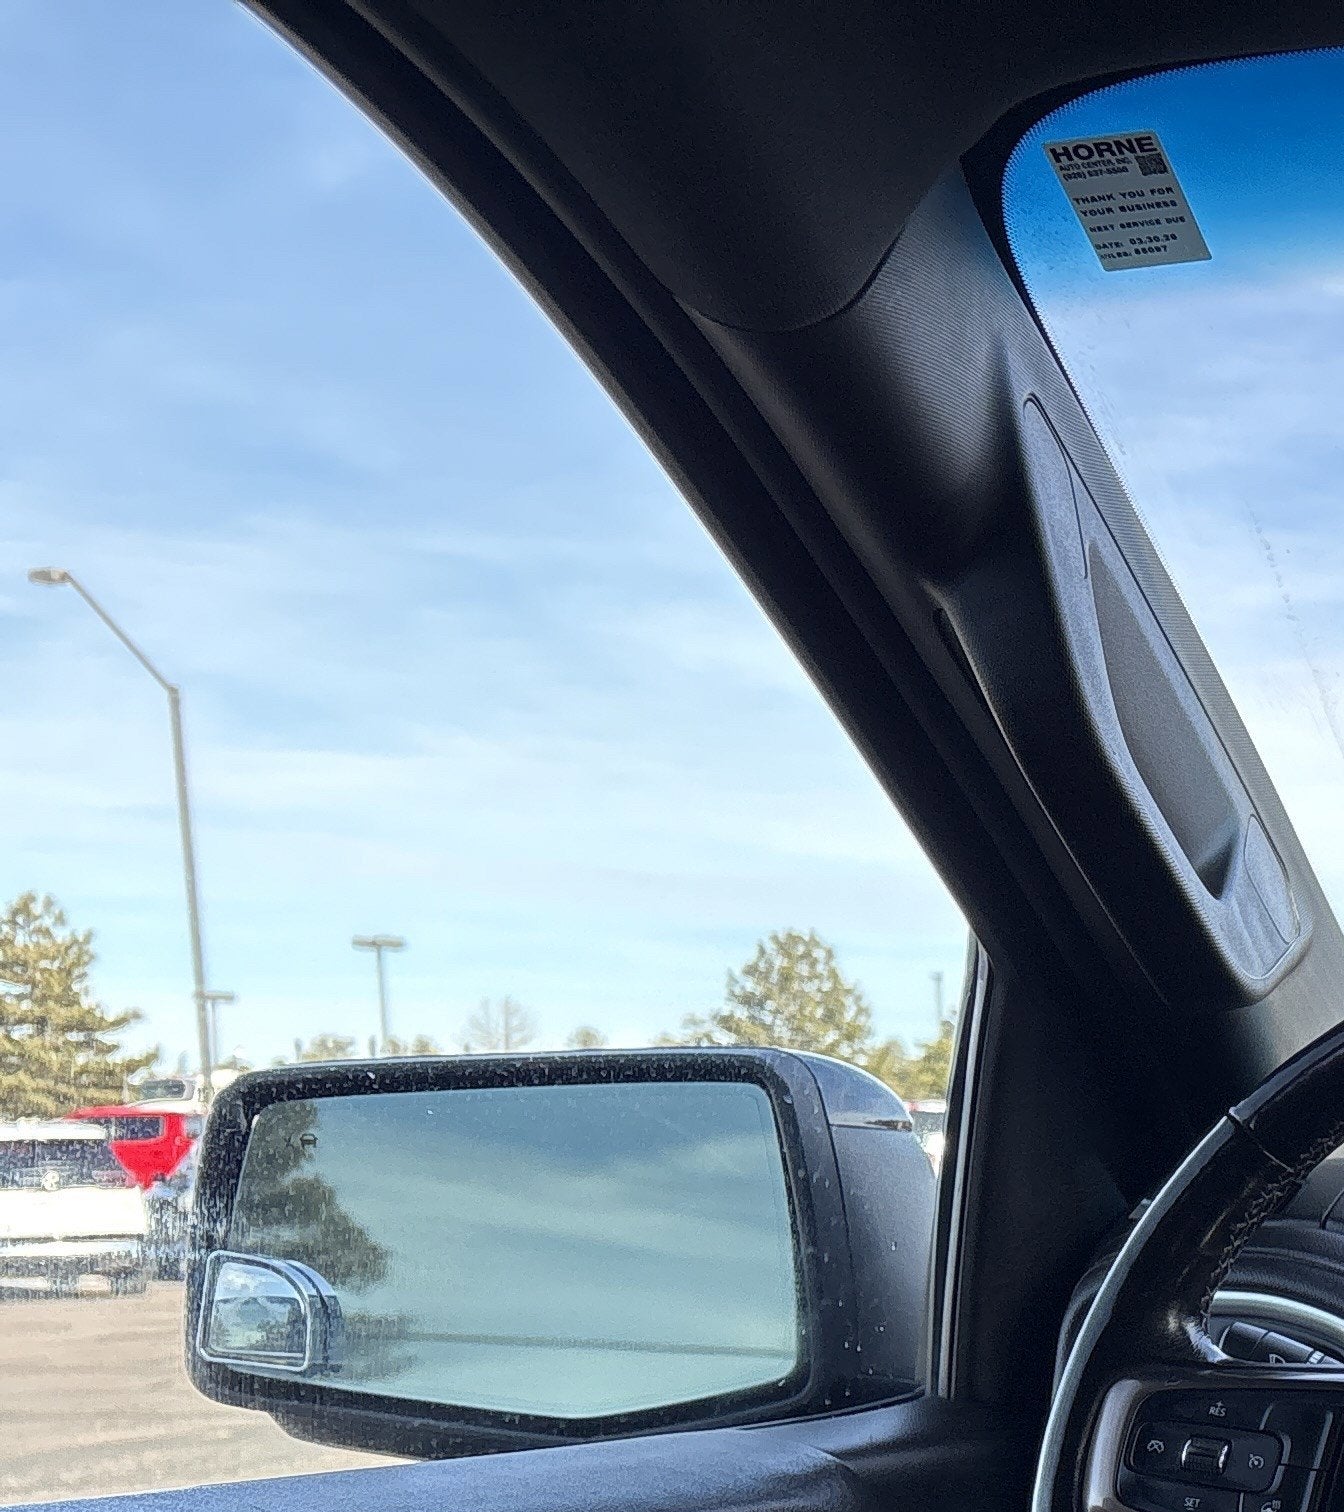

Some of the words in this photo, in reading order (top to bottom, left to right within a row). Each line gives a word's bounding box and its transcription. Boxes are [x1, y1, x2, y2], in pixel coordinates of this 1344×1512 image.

[1049, 136, 1157, 163] HORNE
[1059, 164, 1080, 172] AUTO
[1073, 193, 1116, 205] THANK
[1119, 190, 1146, 199] YOU
[1149, 187, 1174, 196] FOR
[1080, 206, 1114, 217] YOUR
[1119, 200, 1177, 213] BUSINESS
[1089, 224, 1115, 232] NEXT
[1119, 219, 1162, 229] SERVICE
[1165, 216, 1186, 224] DUE
[1208, 1406, 1227, 1418] RES
[1183, 1497, 1201, 1507] SET
